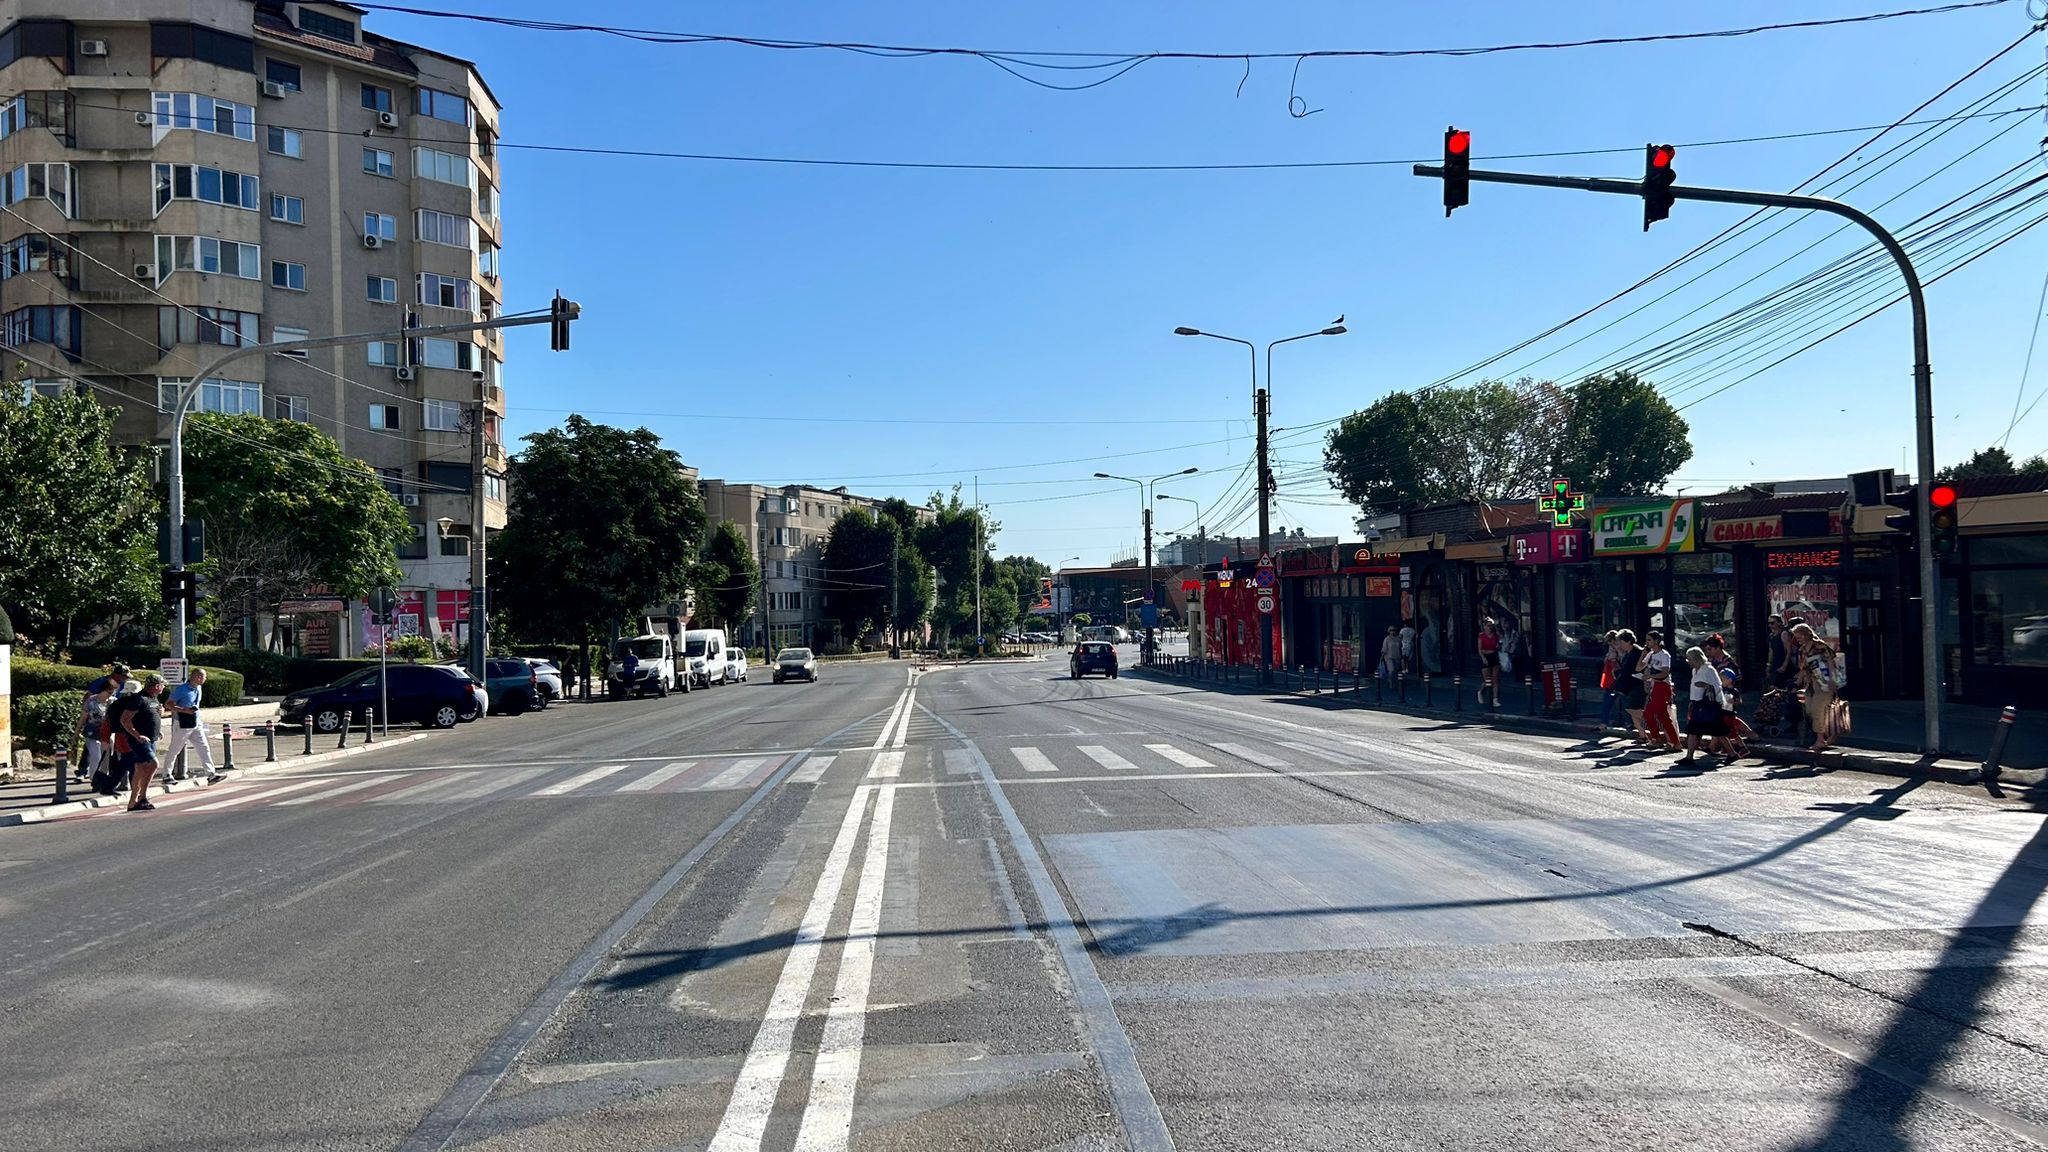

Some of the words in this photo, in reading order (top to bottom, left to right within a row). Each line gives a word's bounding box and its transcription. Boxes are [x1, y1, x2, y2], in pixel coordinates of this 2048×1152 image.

[1601, 512, 1663, 532] CATENA
[1714, 522, 1754, 541] CASA
[1755, 522, 1773, 538] de
[1767, 550, 1840, 568] EXCHANGE
[1246, 578, 1258, 588] 24
[1260, 600, 1271, 610] 30
